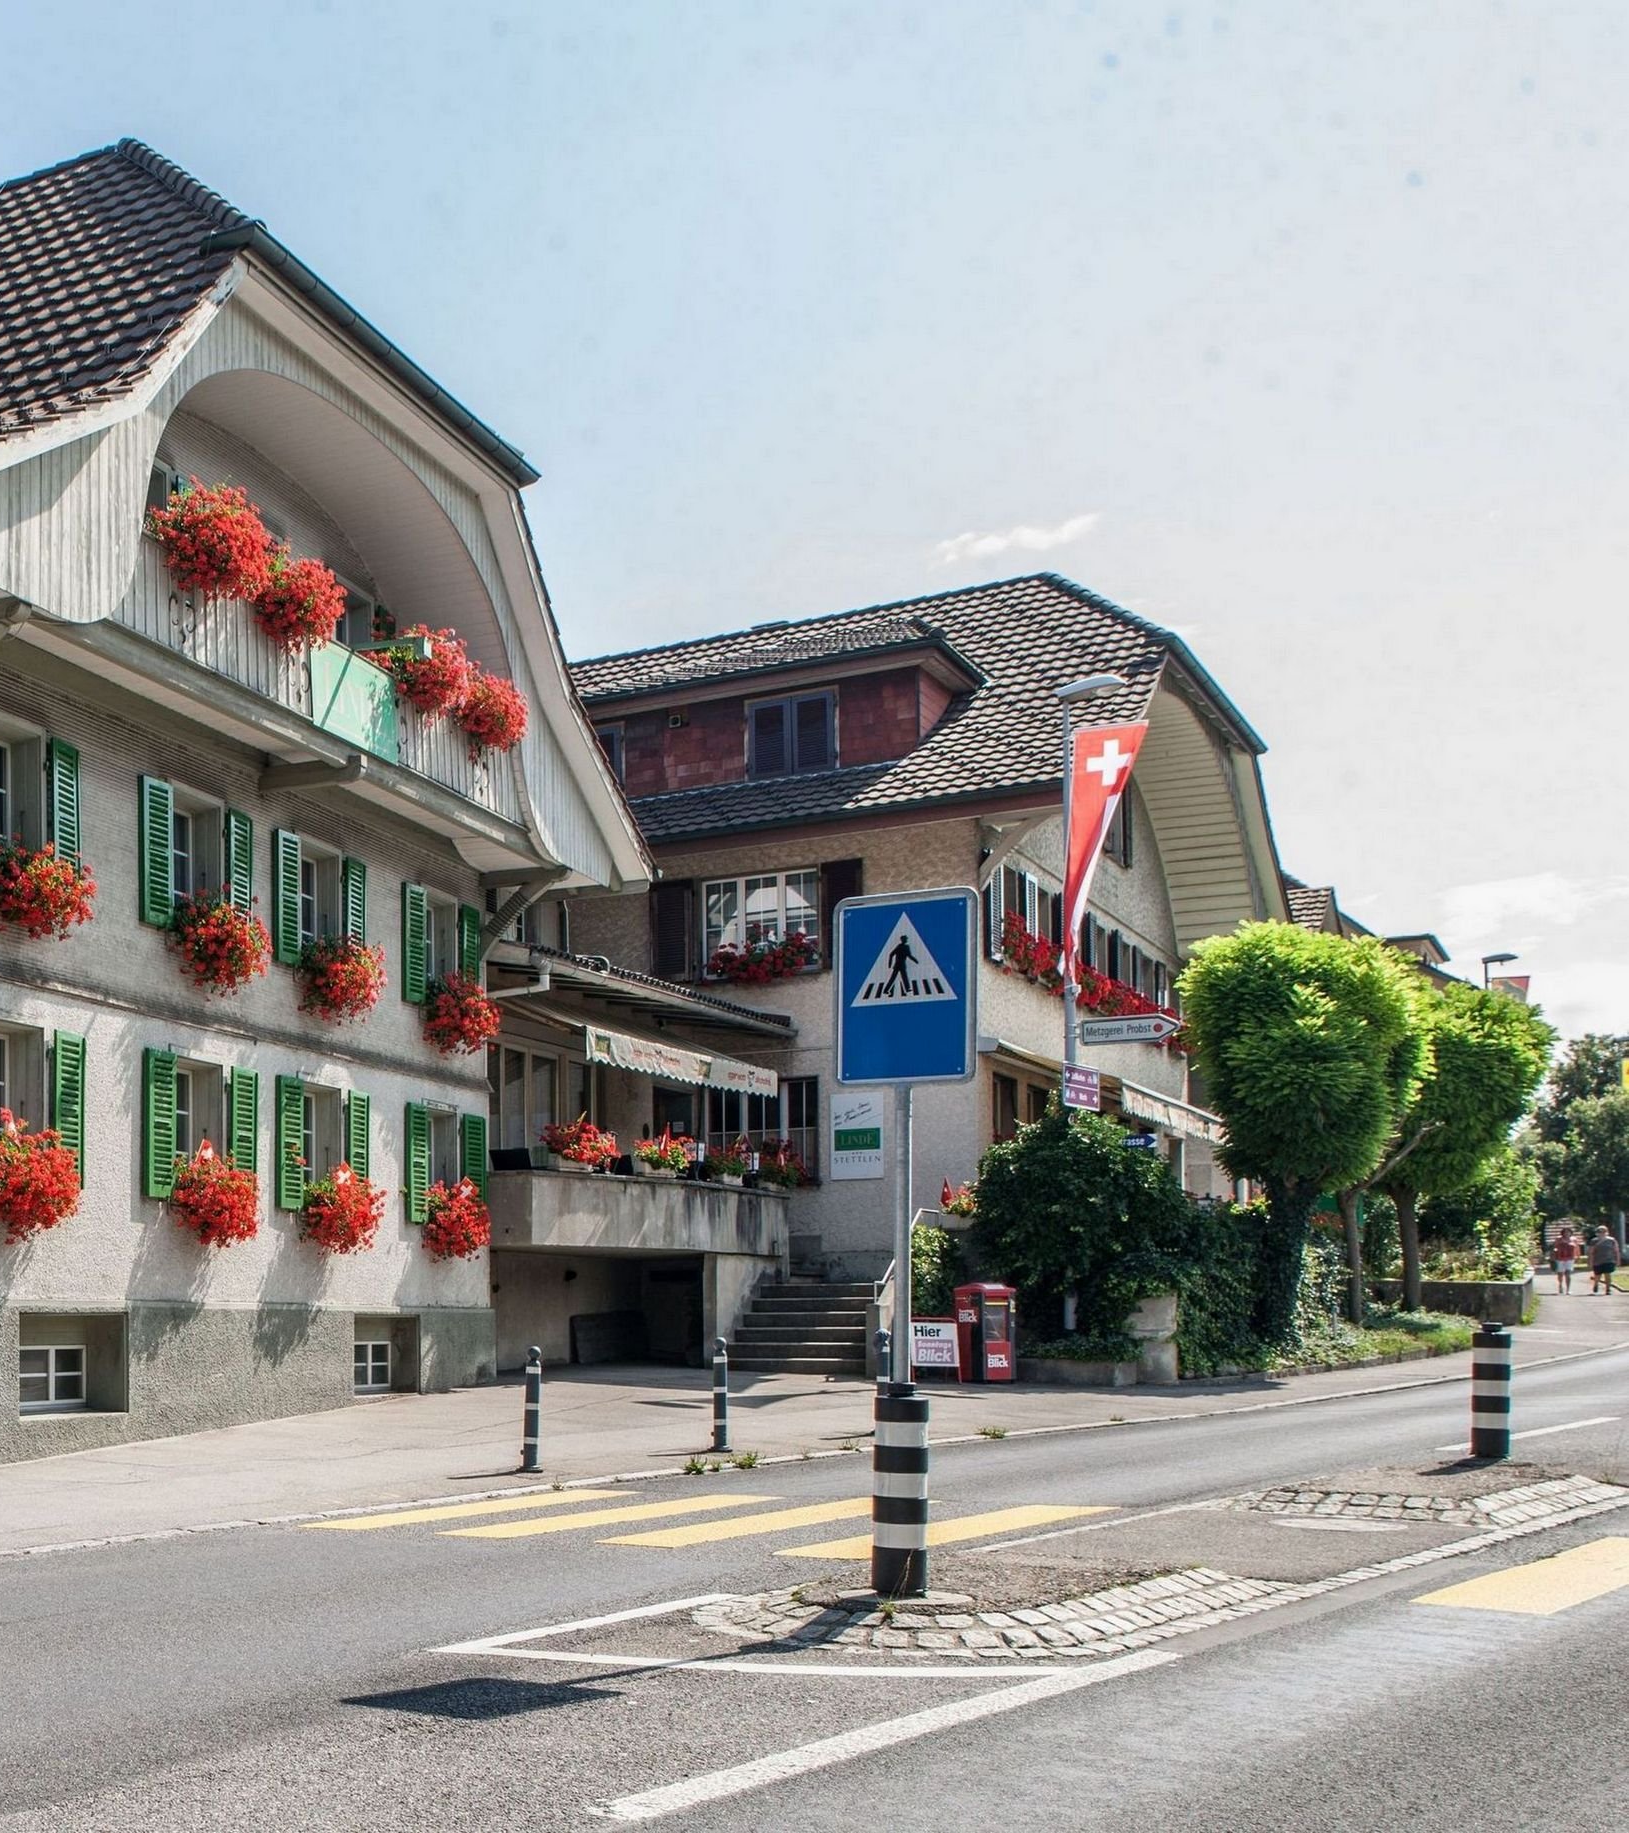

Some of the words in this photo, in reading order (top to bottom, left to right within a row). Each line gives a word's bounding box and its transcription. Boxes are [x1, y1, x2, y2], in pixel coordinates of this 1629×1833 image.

[1085, 1025, 1124, 1038] Metzgerei
[1126, 1024, 1151, 1035] Probst
[841, 1133, 874, 1145] LINDE
[834, 1155, 881, 1164] STETTLEN
[914, 1325, 942, 1337] Hier
[917, 1348, 952, 1362] Blick
[987, 1358, 1009, 1368] Blick
